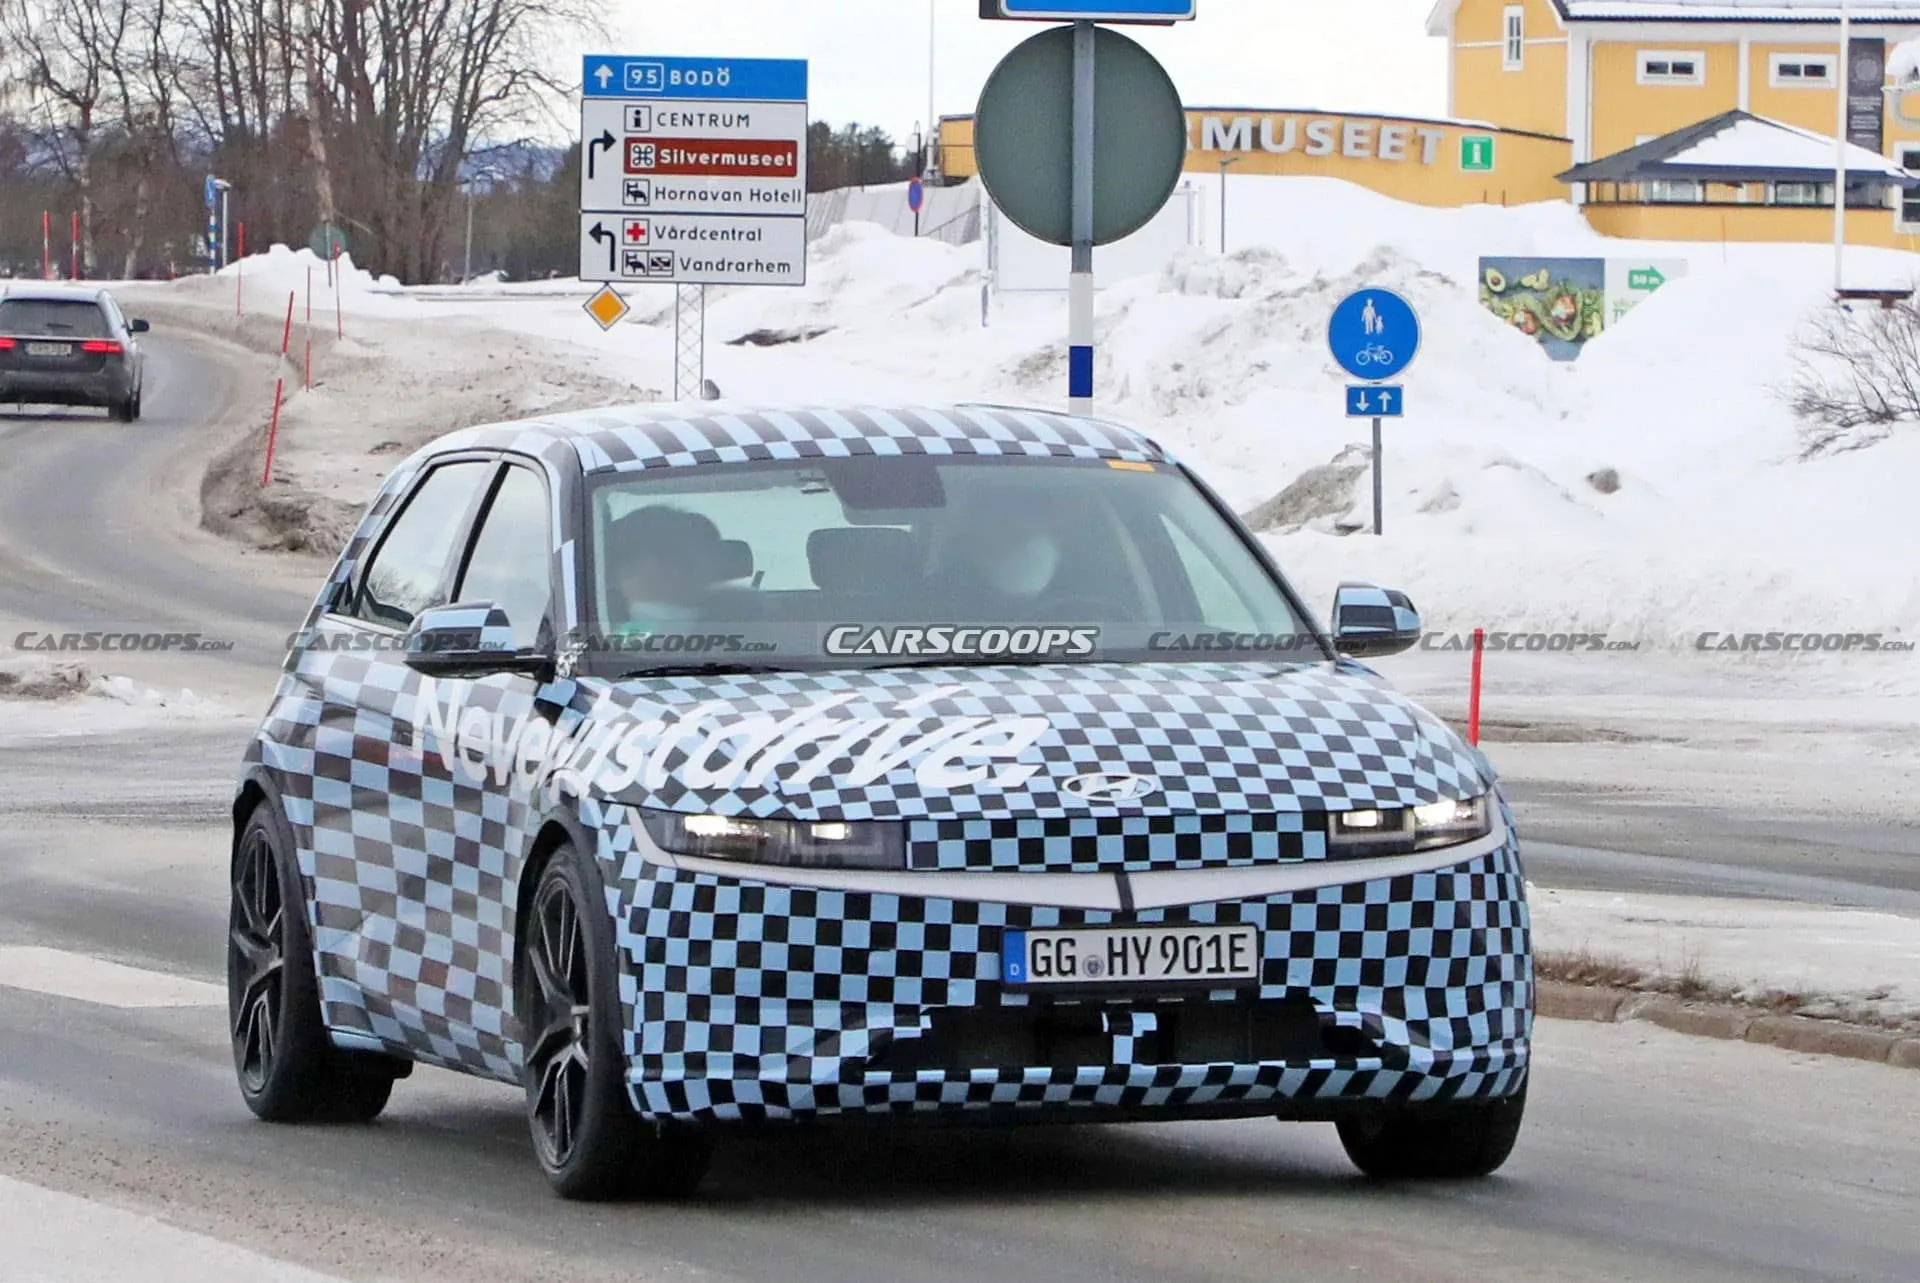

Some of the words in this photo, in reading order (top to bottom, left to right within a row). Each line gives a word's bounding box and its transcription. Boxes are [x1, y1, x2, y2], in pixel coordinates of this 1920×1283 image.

[631, 69, 658, 84] 95
[670, 67, 731, 86] BODÖ
[656, 112, 750, 129] CENTRUM
[1184, 108, 1443, 165] MUSEET
[659, 148, 793, 168] Silvermuseet
[655, 186, 743, 202] Hornavan
[749, 188, 801, 204] Hotell
[654, 225, 763, 242] Vårdcentral
[679, 257, 791, 274] Vandrarhem
[1030, 937, 1076, 977] GG
[1107, 935, 1152, 976] HY
[1160, 932, 1249, 974] 901E
